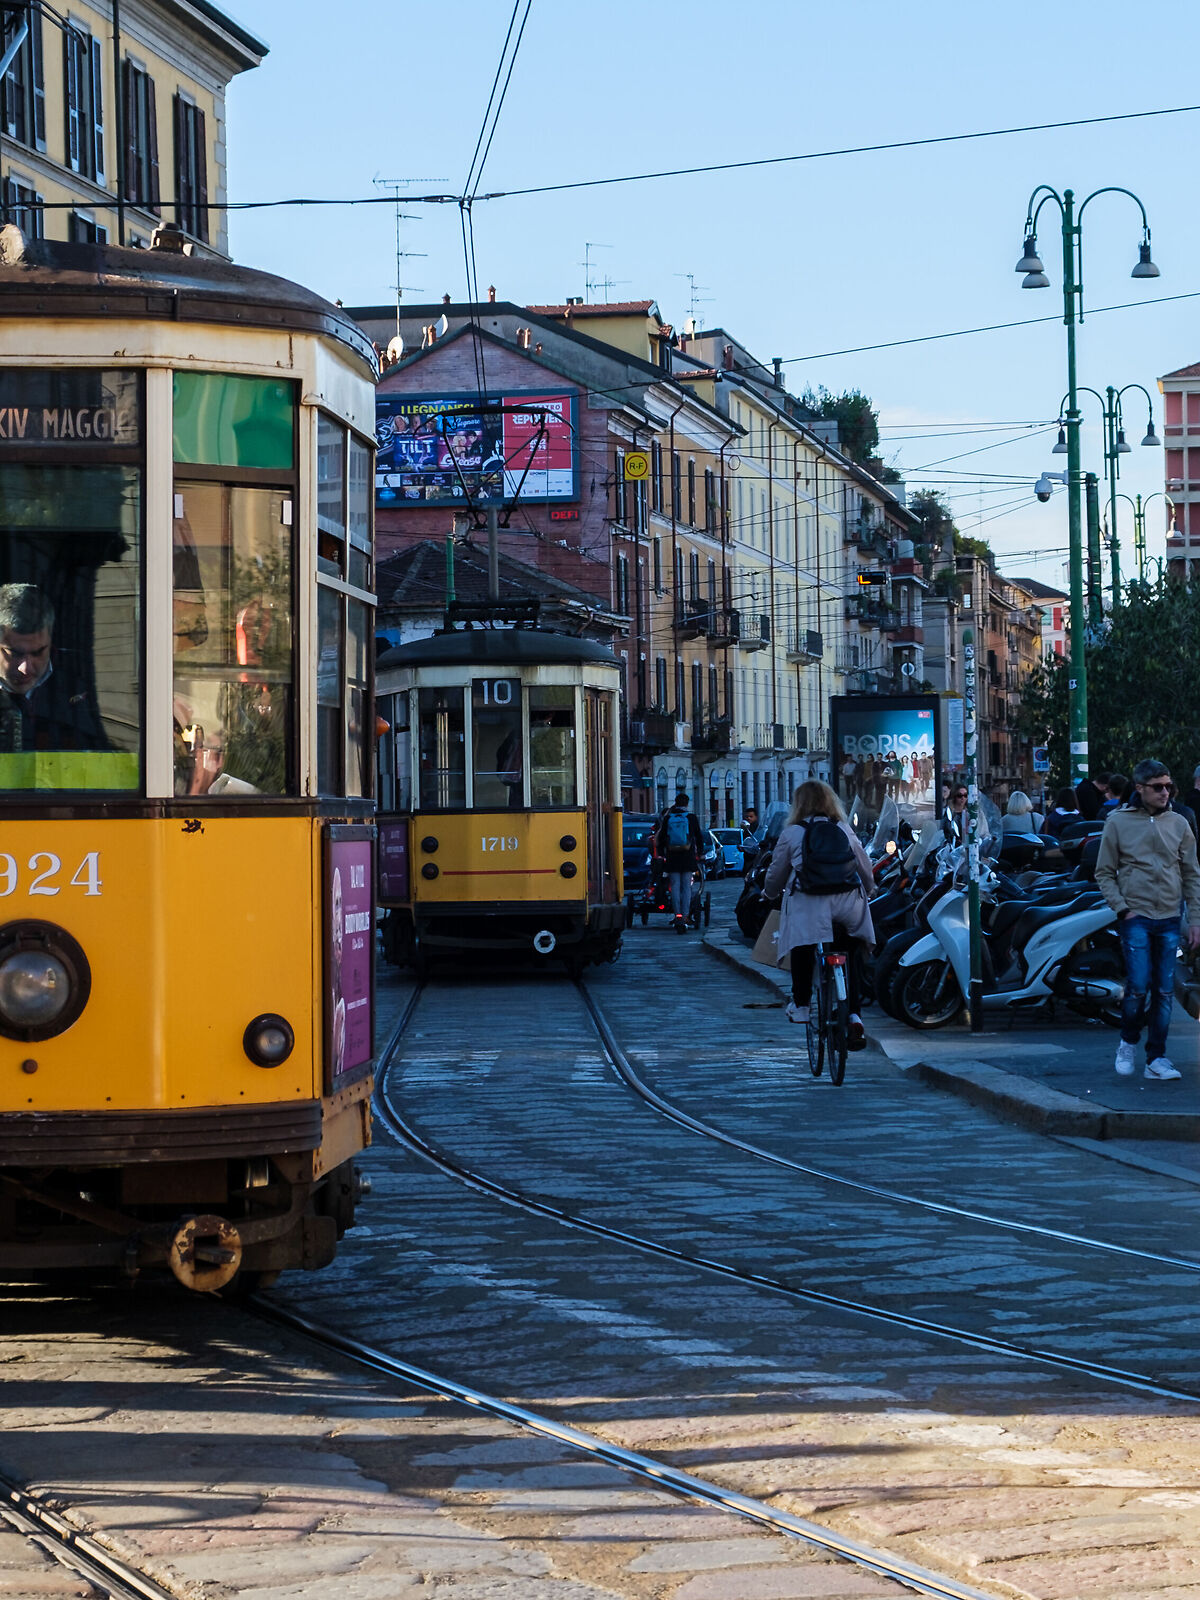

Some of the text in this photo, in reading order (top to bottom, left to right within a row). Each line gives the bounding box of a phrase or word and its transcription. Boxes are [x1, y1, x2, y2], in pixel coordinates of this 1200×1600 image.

[629, 462, 644, 471] R-F
[482, 679, 512, 704] 10
[843, 733, 929, 754] BORIS 4
[481, 837, 518, 851] 1719
